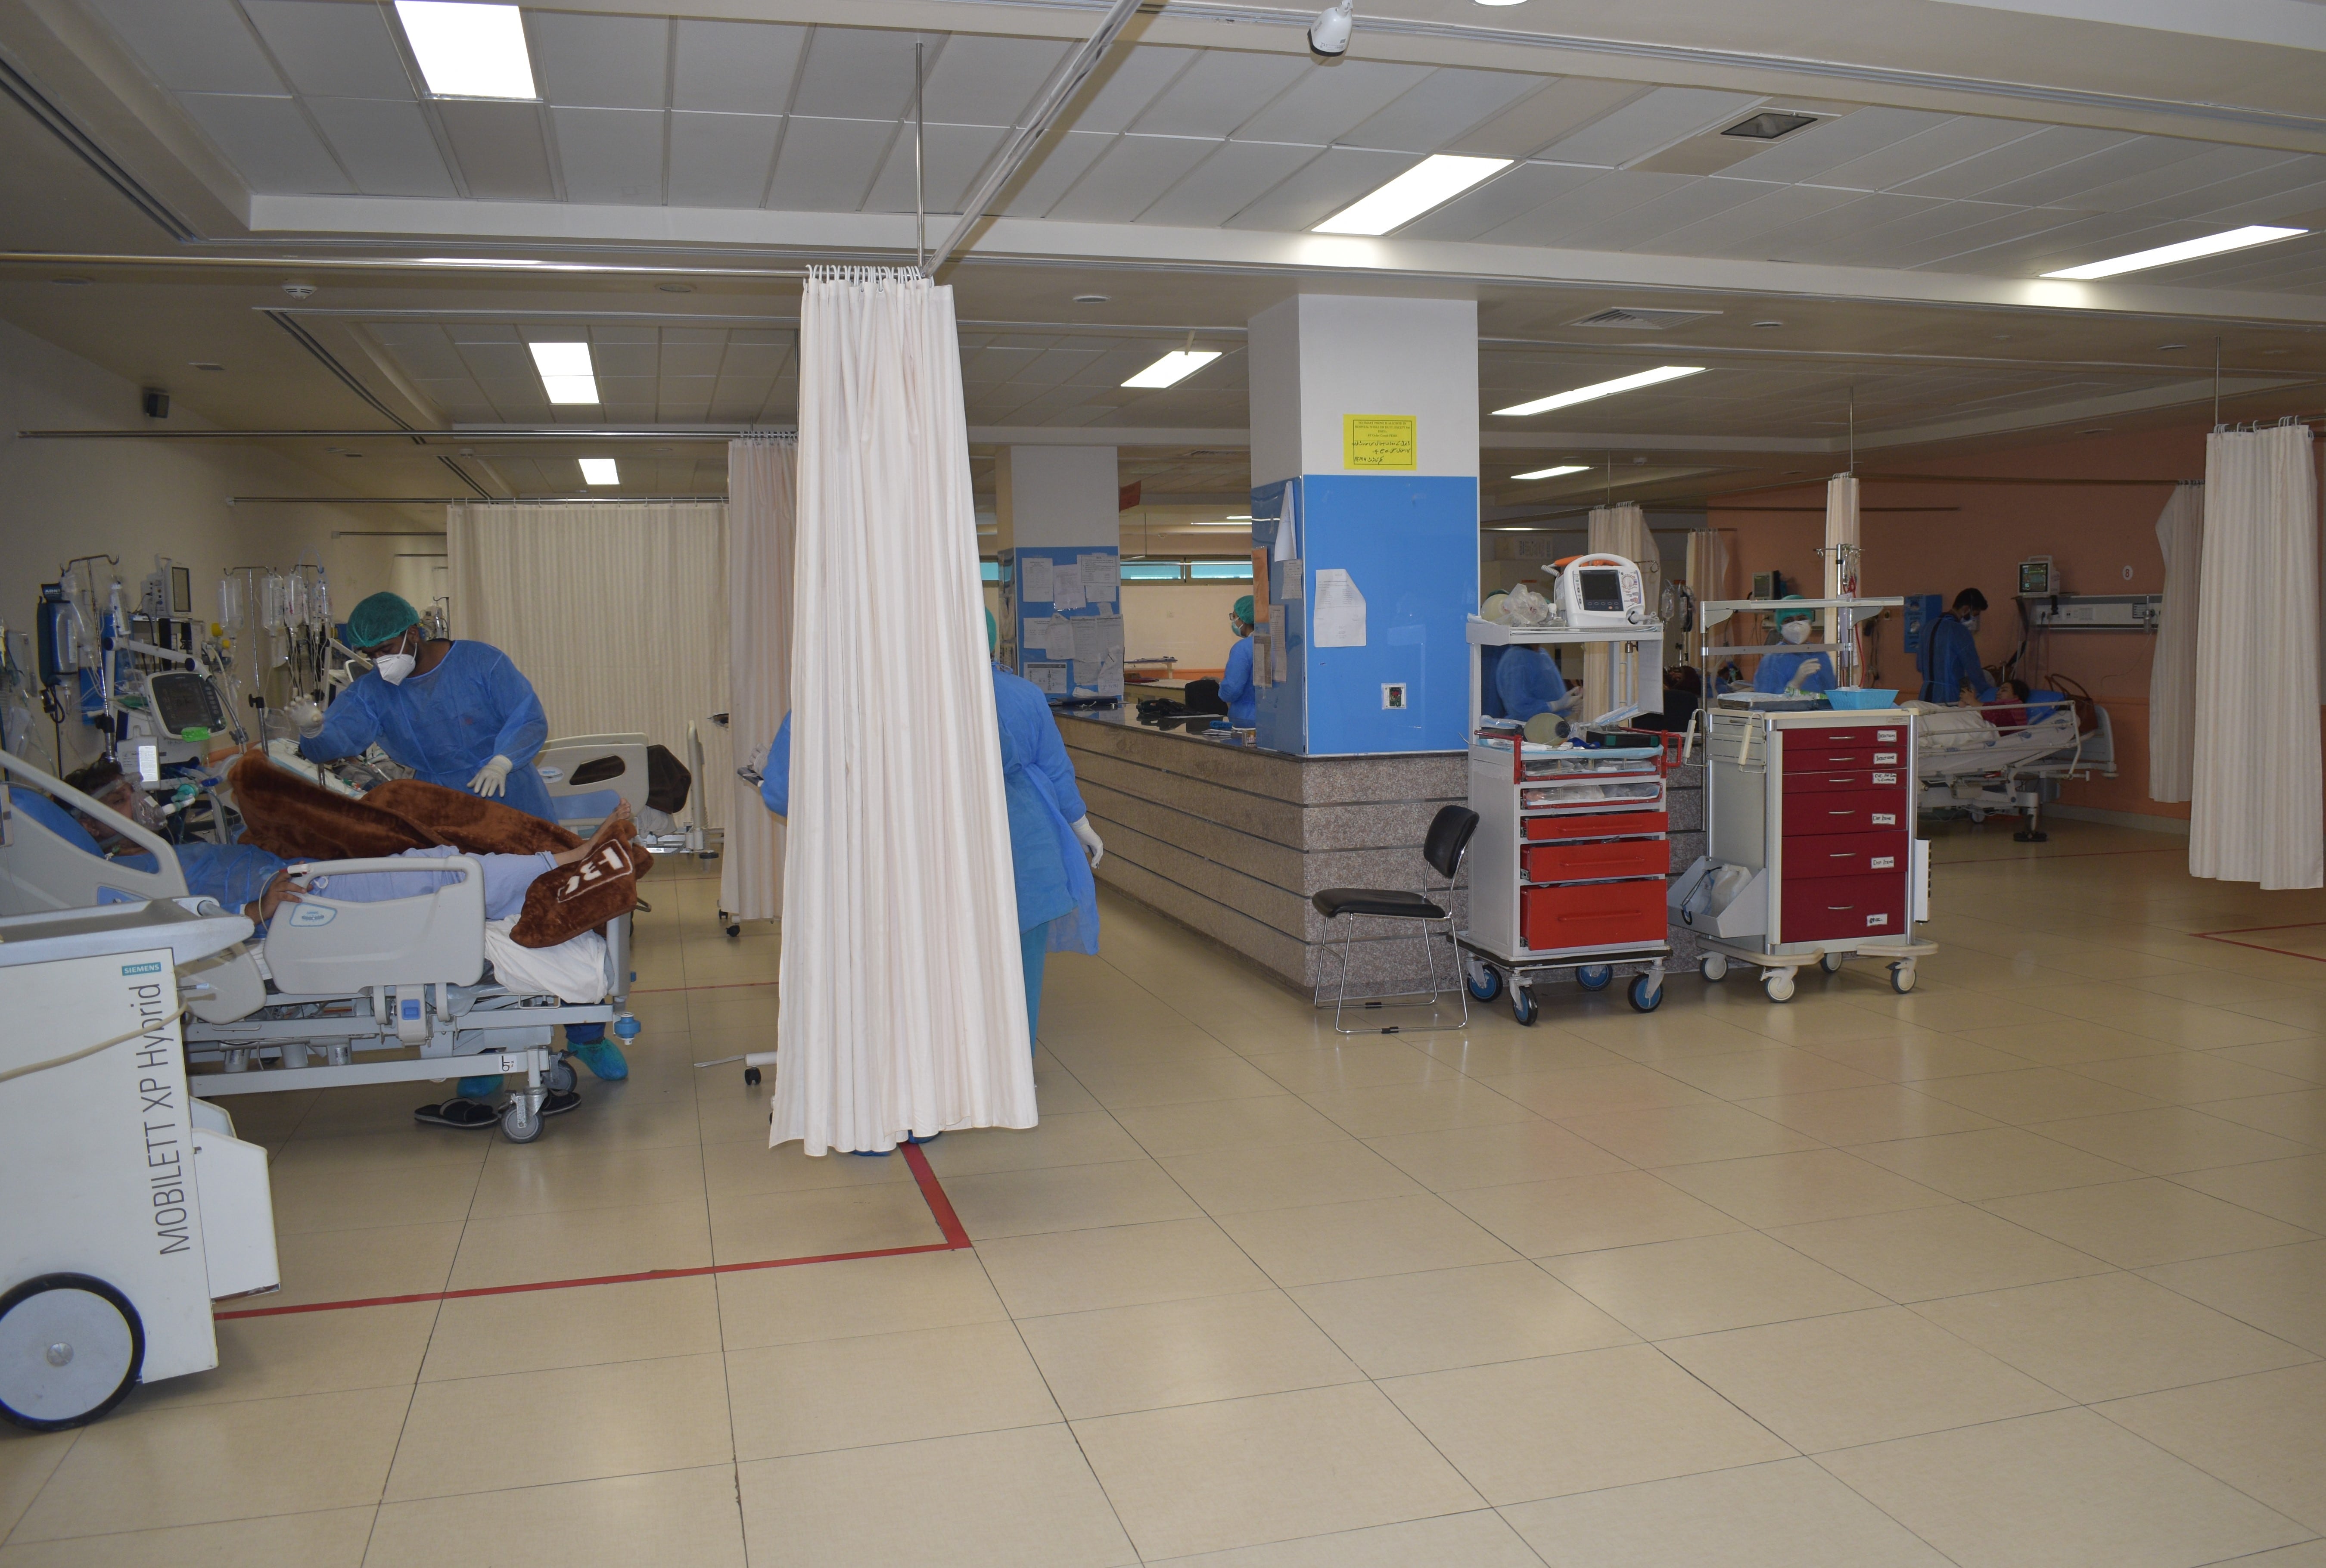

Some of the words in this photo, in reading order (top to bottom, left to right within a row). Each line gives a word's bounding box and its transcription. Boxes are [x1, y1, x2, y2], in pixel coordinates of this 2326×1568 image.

[2125, 569, 2130, 577] 8
[124, 964, 160, 974] SIEMENS
[140, 1078, 174, 1113] XP
[144, 1121, 190, 1255] MOBILETT
